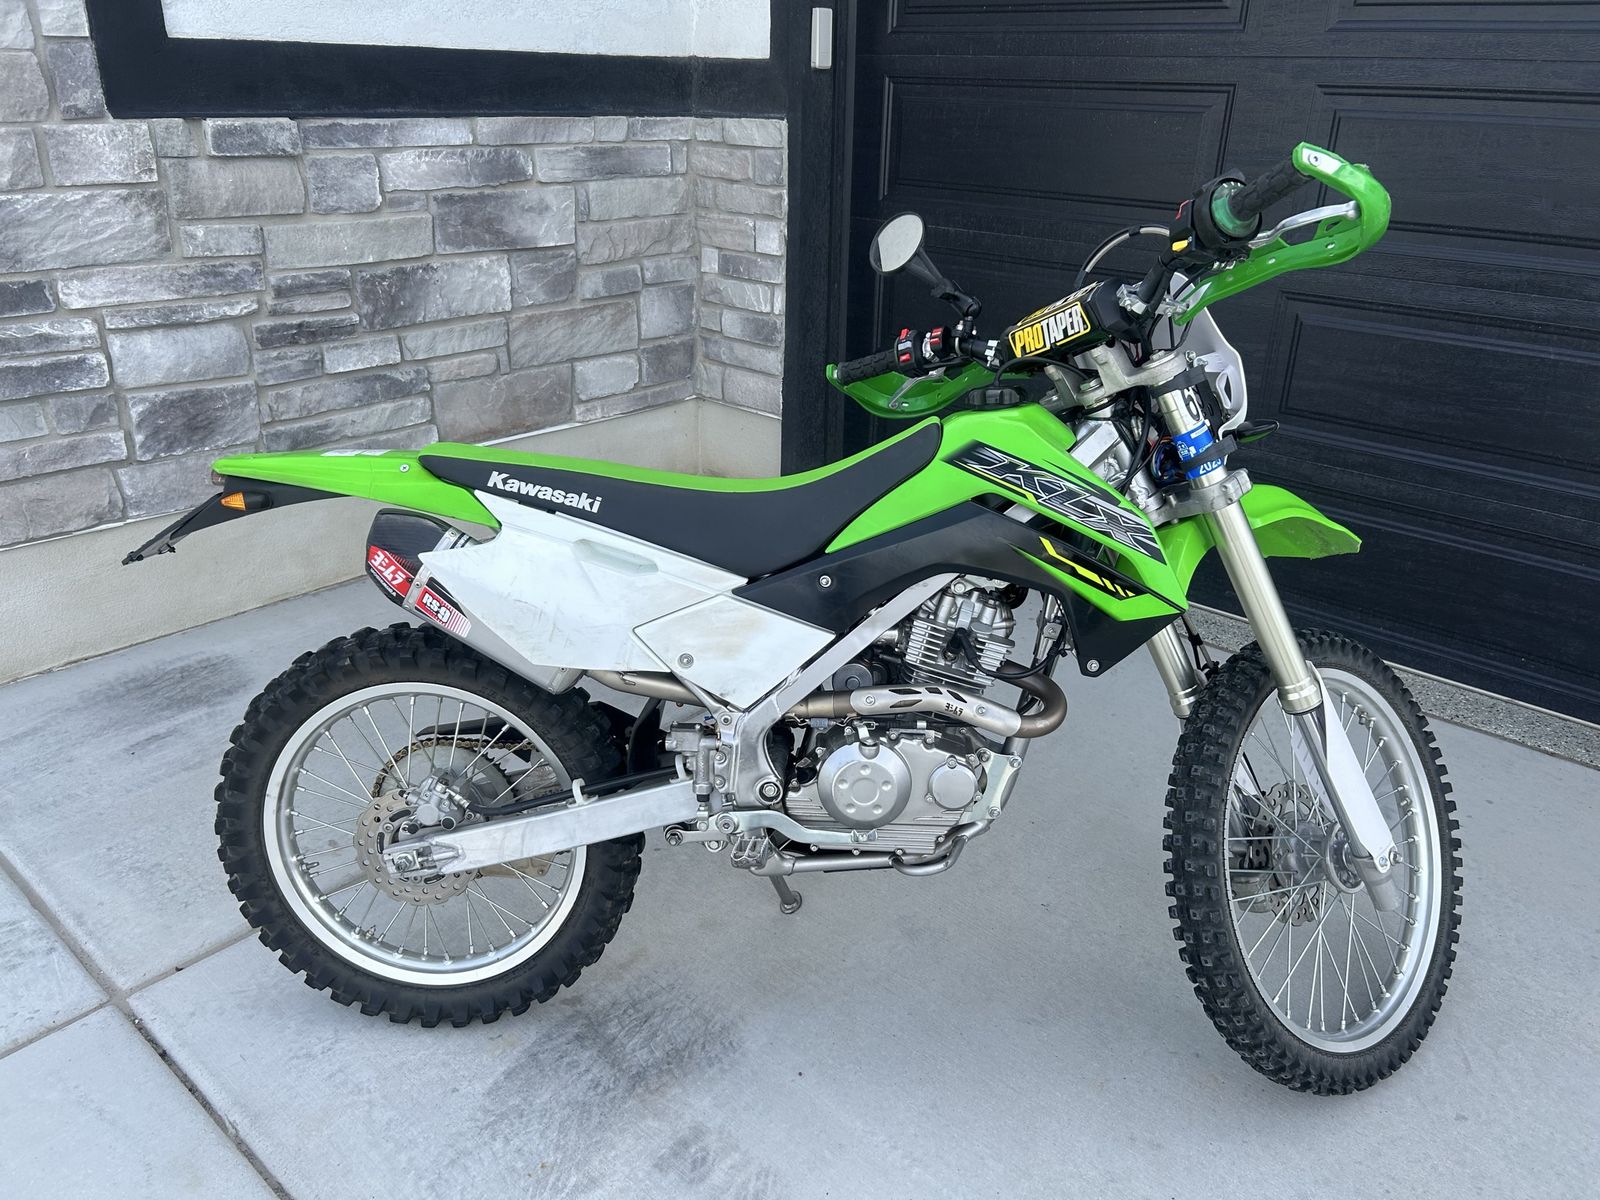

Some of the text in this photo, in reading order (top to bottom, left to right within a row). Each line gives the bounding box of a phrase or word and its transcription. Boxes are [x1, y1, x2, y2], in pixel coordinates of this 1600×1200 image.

[1014, 304, 1084, 357] PROTAPER
[486, 470, 602, 513] Kawasaki
[966, 446, 1160, 557] KLX
